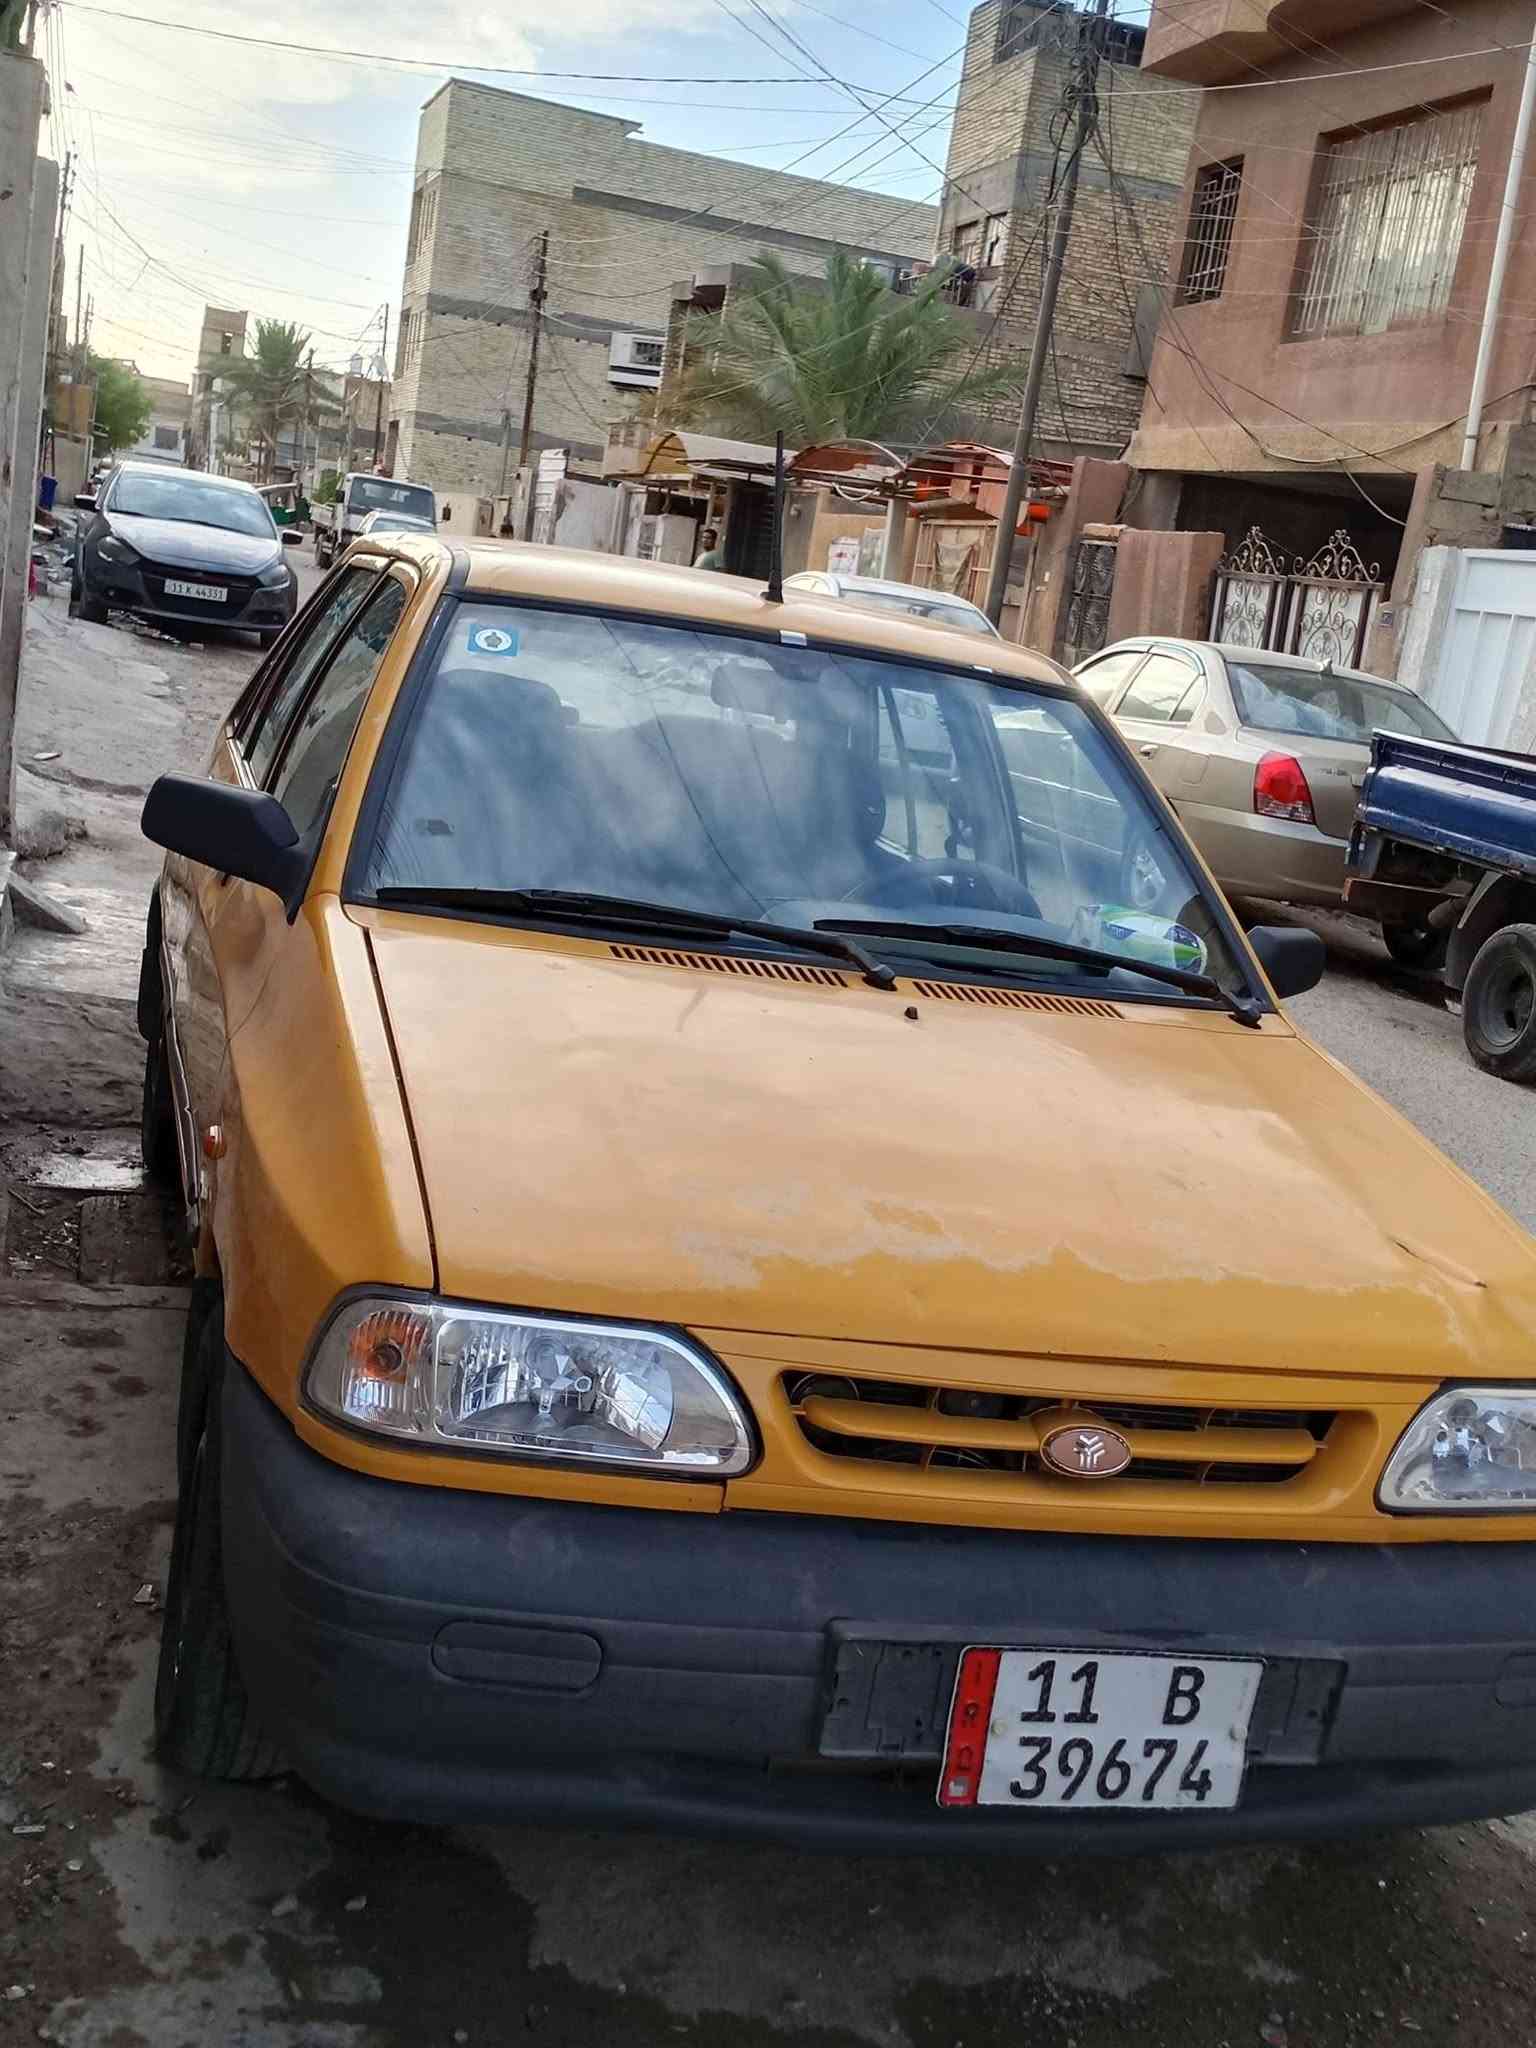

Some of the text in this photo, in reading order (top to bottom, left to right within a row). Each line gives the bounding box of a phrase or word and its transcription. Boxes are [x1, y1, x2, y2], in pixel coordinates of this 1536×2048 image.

[172, 582, 183, 594] 11
[1020, 1660, 1205, 1725] 11 B
[1009, 1736, 1213, 1801] 39674
